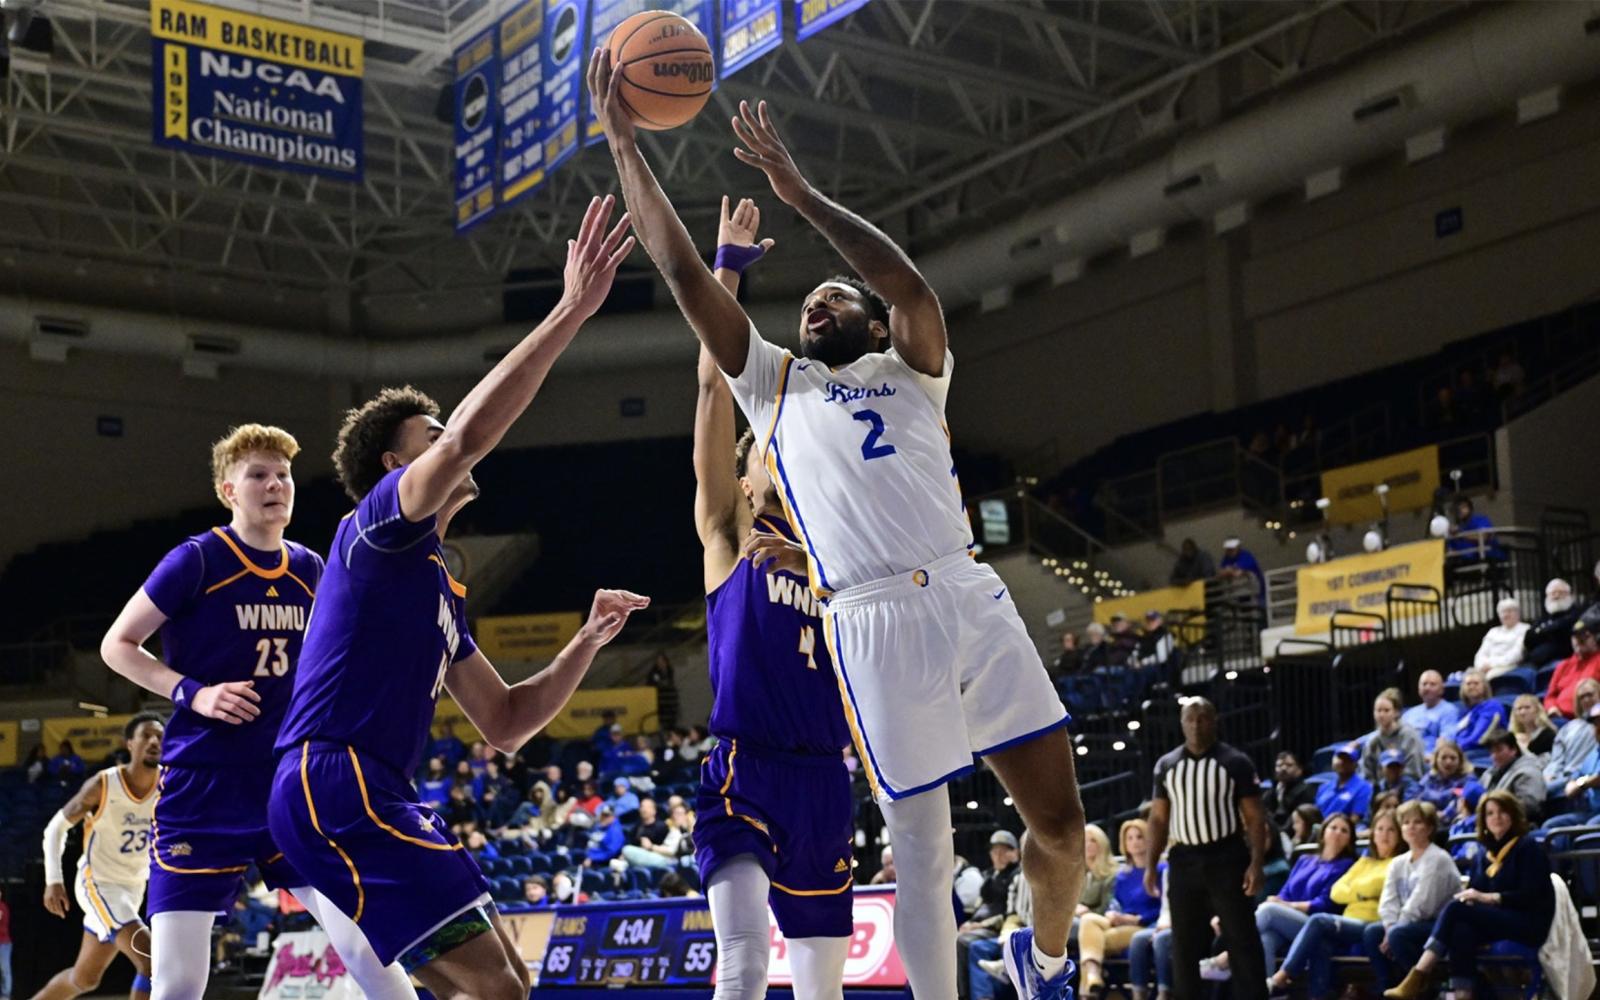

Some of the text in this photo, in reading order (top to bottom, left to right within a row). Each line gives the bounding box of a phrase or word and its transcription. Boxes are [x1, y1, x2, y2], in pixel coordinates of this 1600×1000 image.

[160, 8, 355, 70] RAM BASKETBALL
[201, 50, 345, 104] NJCAA
[653, 60, 713, 83] Wilson
[213, 90, 334, 134] National
[191, 117, 357, 169] Champions
[825, 382, 896, 403] Rams
[852, 409, 897, 461] 2
[235, 604, 305, 631] WNMU
[253, 638, 289, 677] 23
[798, 625, 817, 670] 4
[122, 811, 150, 826] Ram
[120, 829, 149, 853] 23
[613, 918, 653, 945] 4:04
[547, 945, 573, 972] 65
[684, 942, 714, 971] 55
